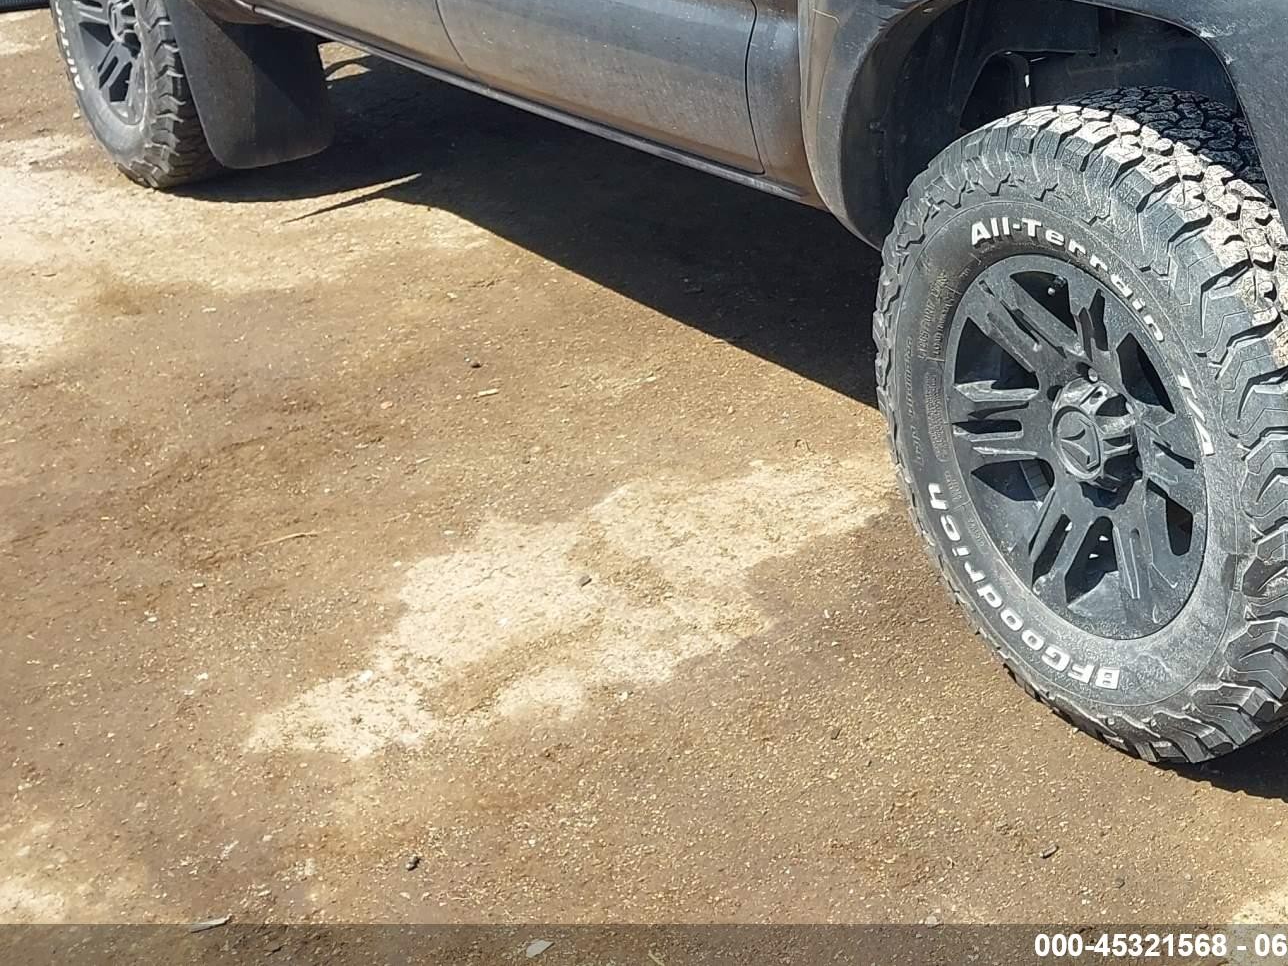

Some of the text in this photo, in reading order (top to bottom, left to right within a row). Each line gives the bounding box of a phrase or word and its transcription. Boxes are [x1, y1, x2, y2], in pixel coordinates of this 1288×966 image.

[971, 216, 1215, 456] All-Terrain T/A
[928, 483, 1121, 691] BFGoodrich
